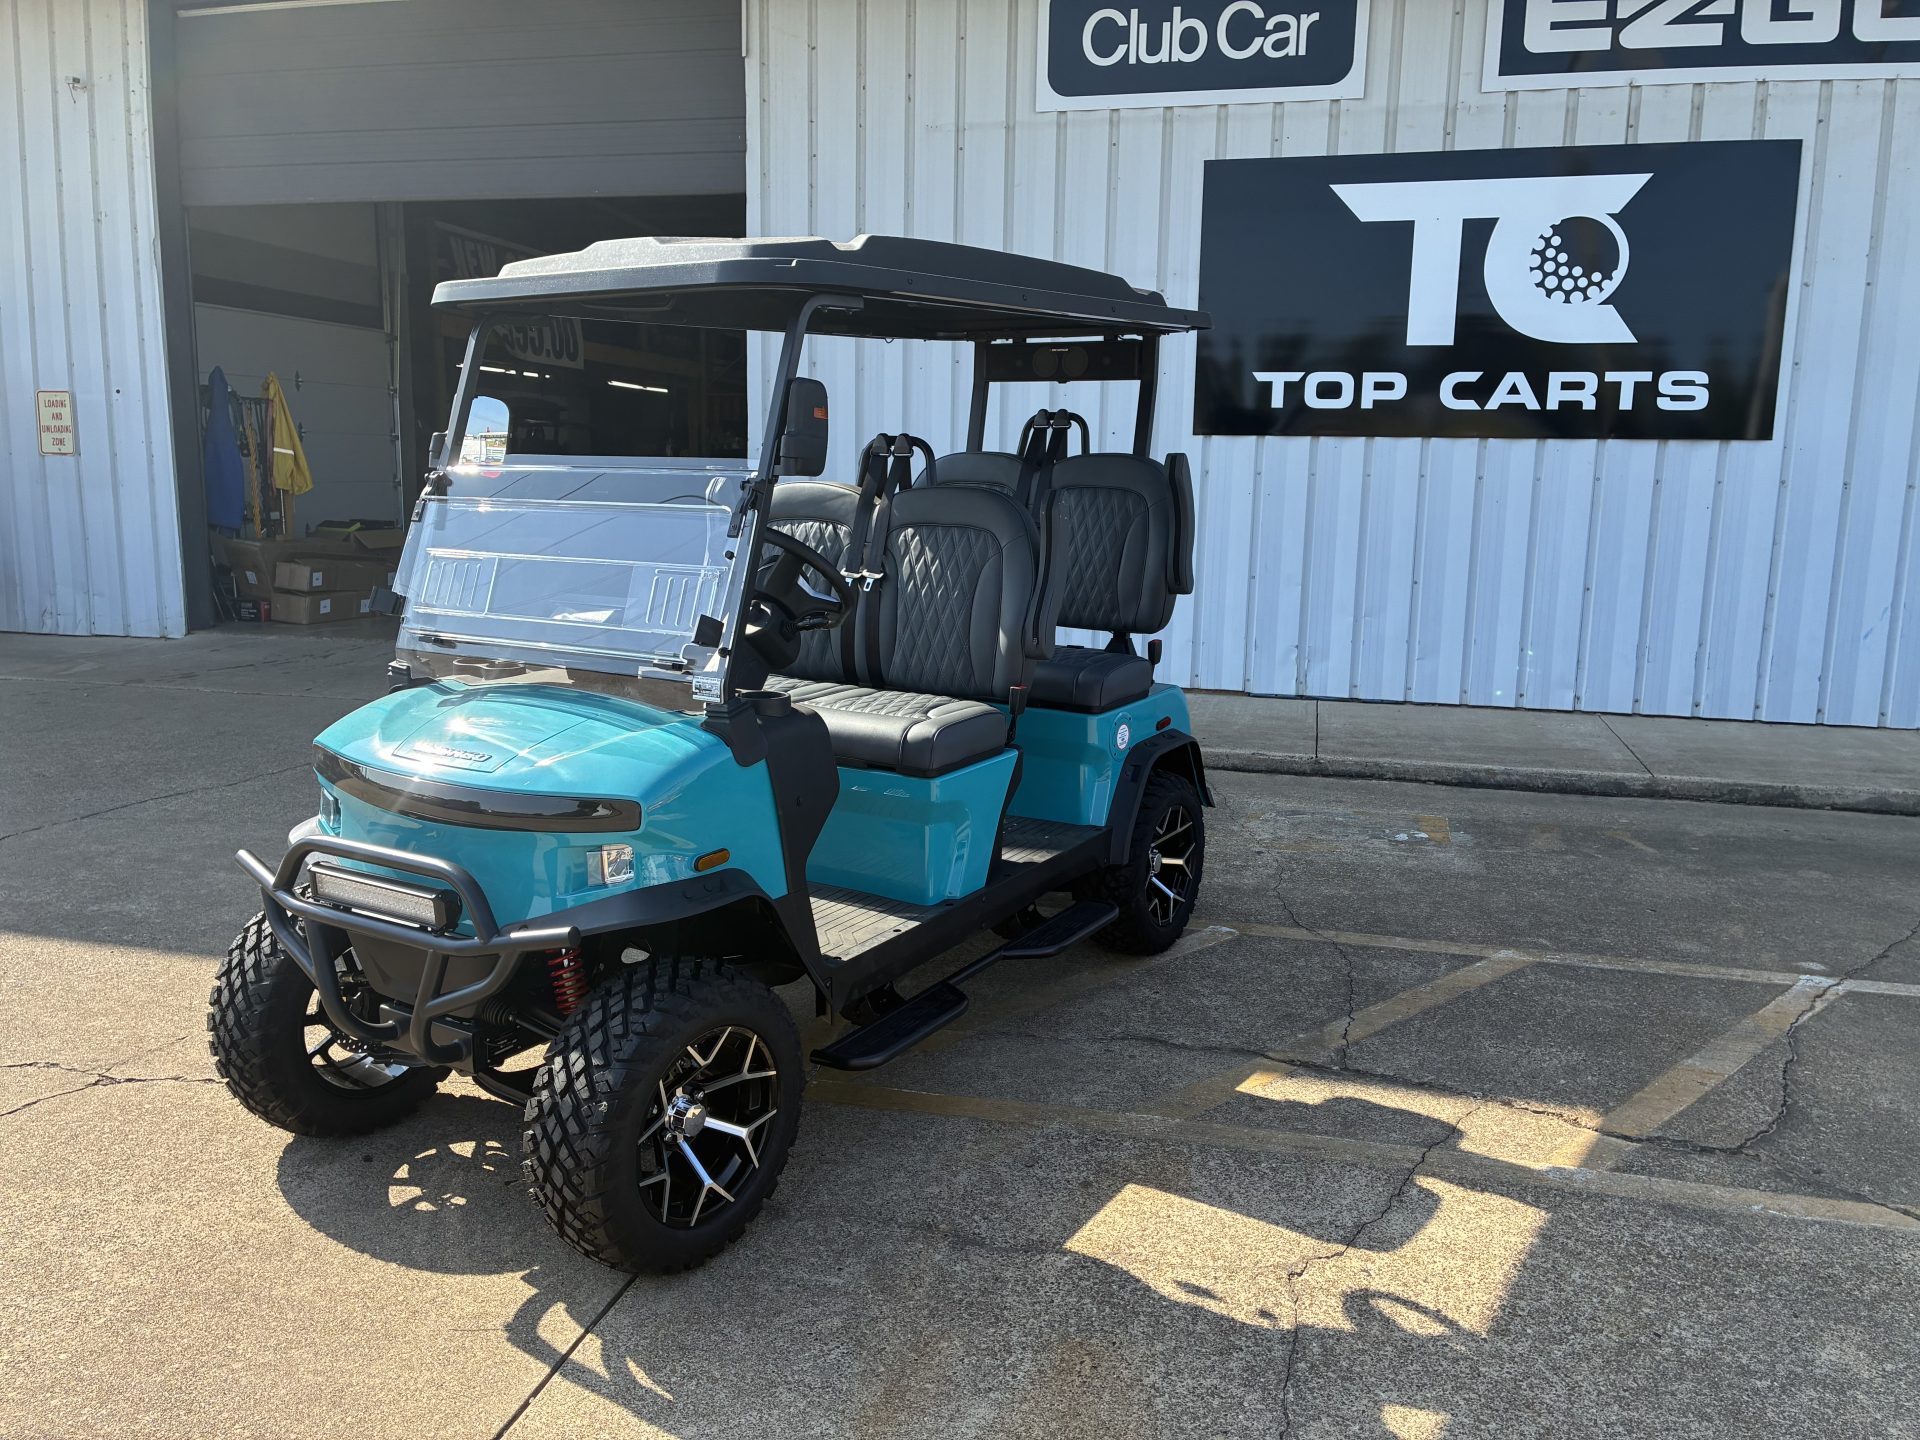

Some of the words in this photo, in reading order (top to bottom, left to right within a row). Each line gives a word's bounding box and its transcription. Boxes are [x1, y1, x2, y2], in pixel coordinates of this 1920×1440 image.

[1082, 6, 1208, 66] Club
[1216, 0, 1320, 60] Car
[1252, 371, 1407, 409] TOP
[1439, 371, 1709, 411] CARTS
[43, 399, 67, 408] LOADING
[51, 412, 63, 421] AND
[41, 424, 72, 434] UNLOADING
[51, 437, 66, 447] ZONE
